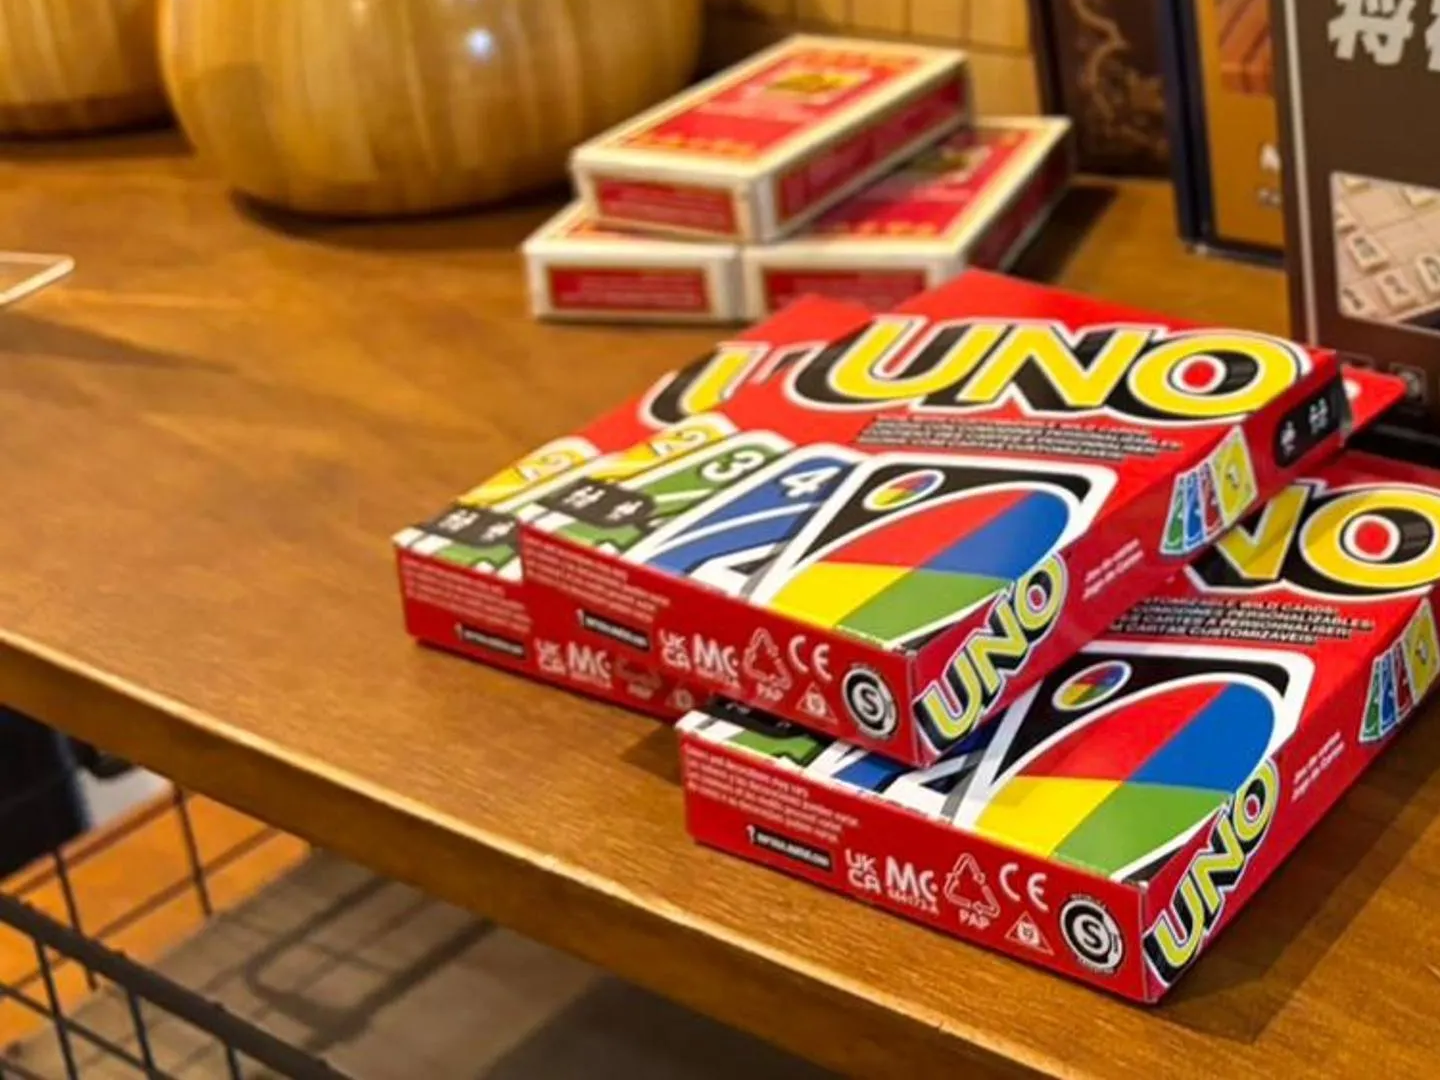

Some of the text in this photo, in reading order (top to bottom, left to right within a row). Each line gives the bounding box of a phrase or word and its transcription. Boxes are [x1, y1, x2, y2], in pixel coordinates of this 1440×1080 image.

[795, 317, 1308, 419] UNO
[701, 449, 765, 483] 3
[780, 465, 842, 499] 4
[914, 553, 1067, 754] UNO
[1143, 759, 1279, 985] UNO
